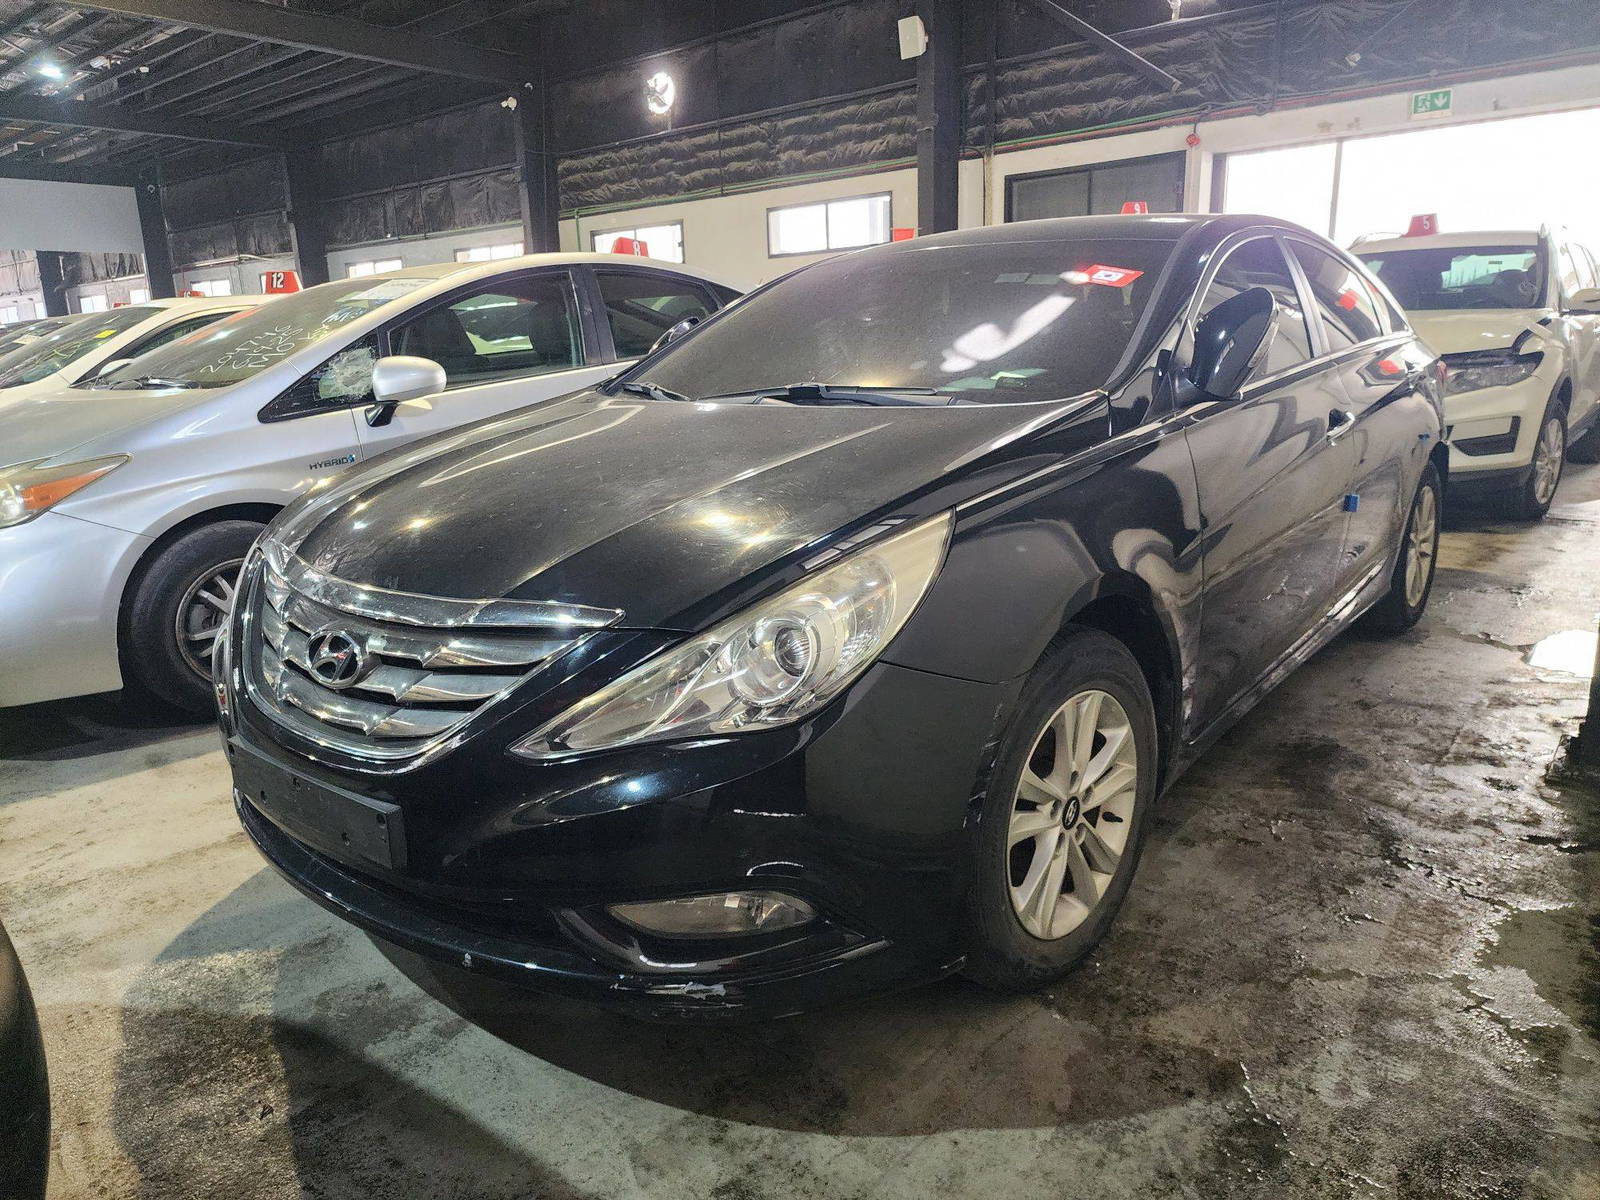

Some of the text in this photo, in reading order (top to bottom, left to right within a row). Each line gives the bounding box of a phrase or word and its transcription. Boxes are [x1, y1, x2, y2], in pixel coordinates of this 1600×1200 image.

[1423, 215, 1431, 230] 5
[271, 272, 285, 289] 12
[309, 456, 349, 470] HYBRID
